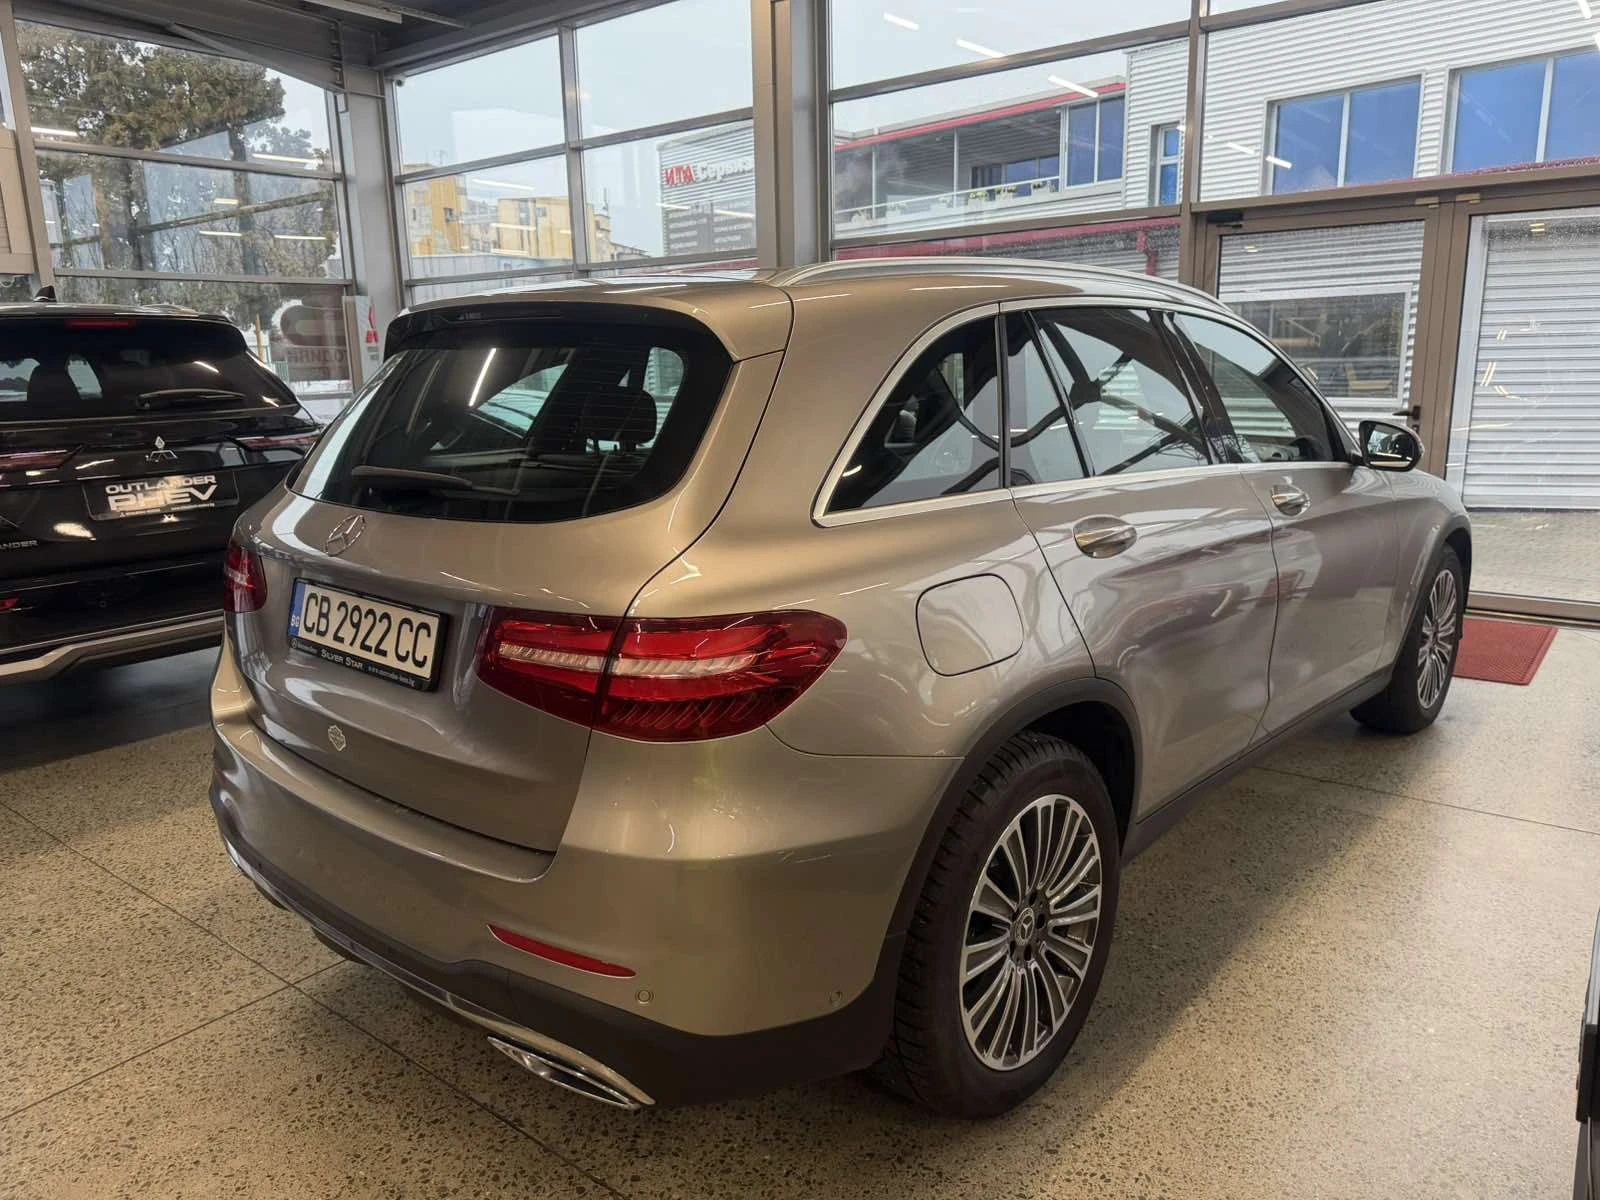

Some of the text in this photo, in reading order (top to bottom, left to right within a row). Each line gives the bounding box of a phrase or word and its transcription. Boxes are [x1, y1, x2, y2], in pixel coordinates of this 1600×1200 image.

[105, 475, 216, 494] OUTLANDER
[107, 484, 218, 512] PHEV
[0, 539, 39, 549] NDER
[303, 592, 431, 669] CB 2922 CC
